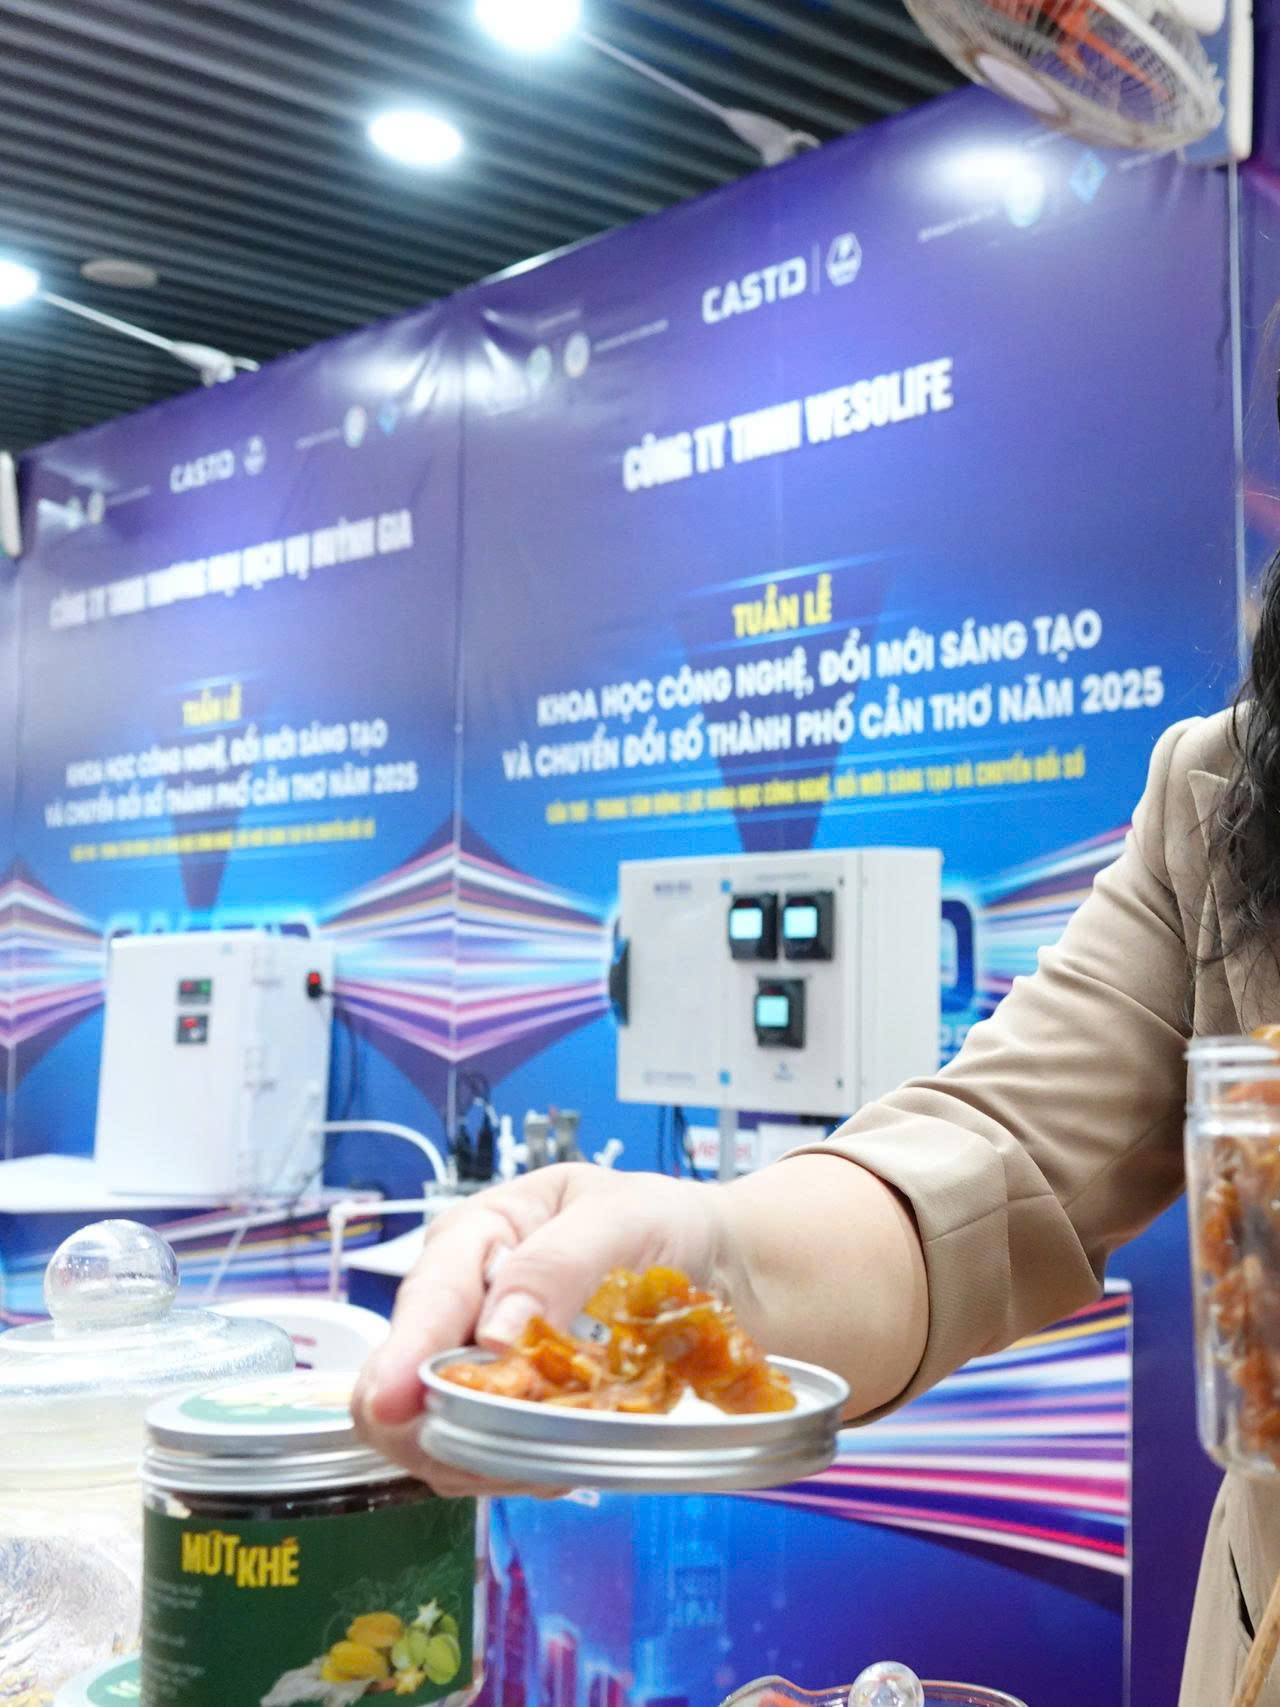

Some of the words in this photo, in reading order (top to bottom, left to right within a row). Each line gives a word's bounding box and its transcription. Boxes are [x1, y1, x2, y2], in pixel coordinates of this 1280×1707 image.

[694, 421, 726, 474] TY
[732, 583, 799, 639] TUẦN
[803, 573, 832, 625] LỄ
[537, 688, 599, 727] KHOA
[601, 679, 654, 723] HỌC
[657, 664, 732, 710] CÔNG
[735, 645, 815, 700] NGHỆ,
[818, 627, 871, 686] ĐỔI
[876, 626, 935, 679] MỚI
[940, 617, 1029, 670] SÁNG
[1032, 609, 1102, 663] TẠO
[502, 741, 533, 781] VÀ
[670, 712, 705, 762] SỐ
[707, 710, 791, 757] THÀNH
[795, 692, 856, 747] PHỐ
[859, 684, 924, 740] CẦN
[928, 683, 993, 732] THƠ
[998, 673, 1074, 725] NĂM
[1080, 666, 1164, 714] 2025
